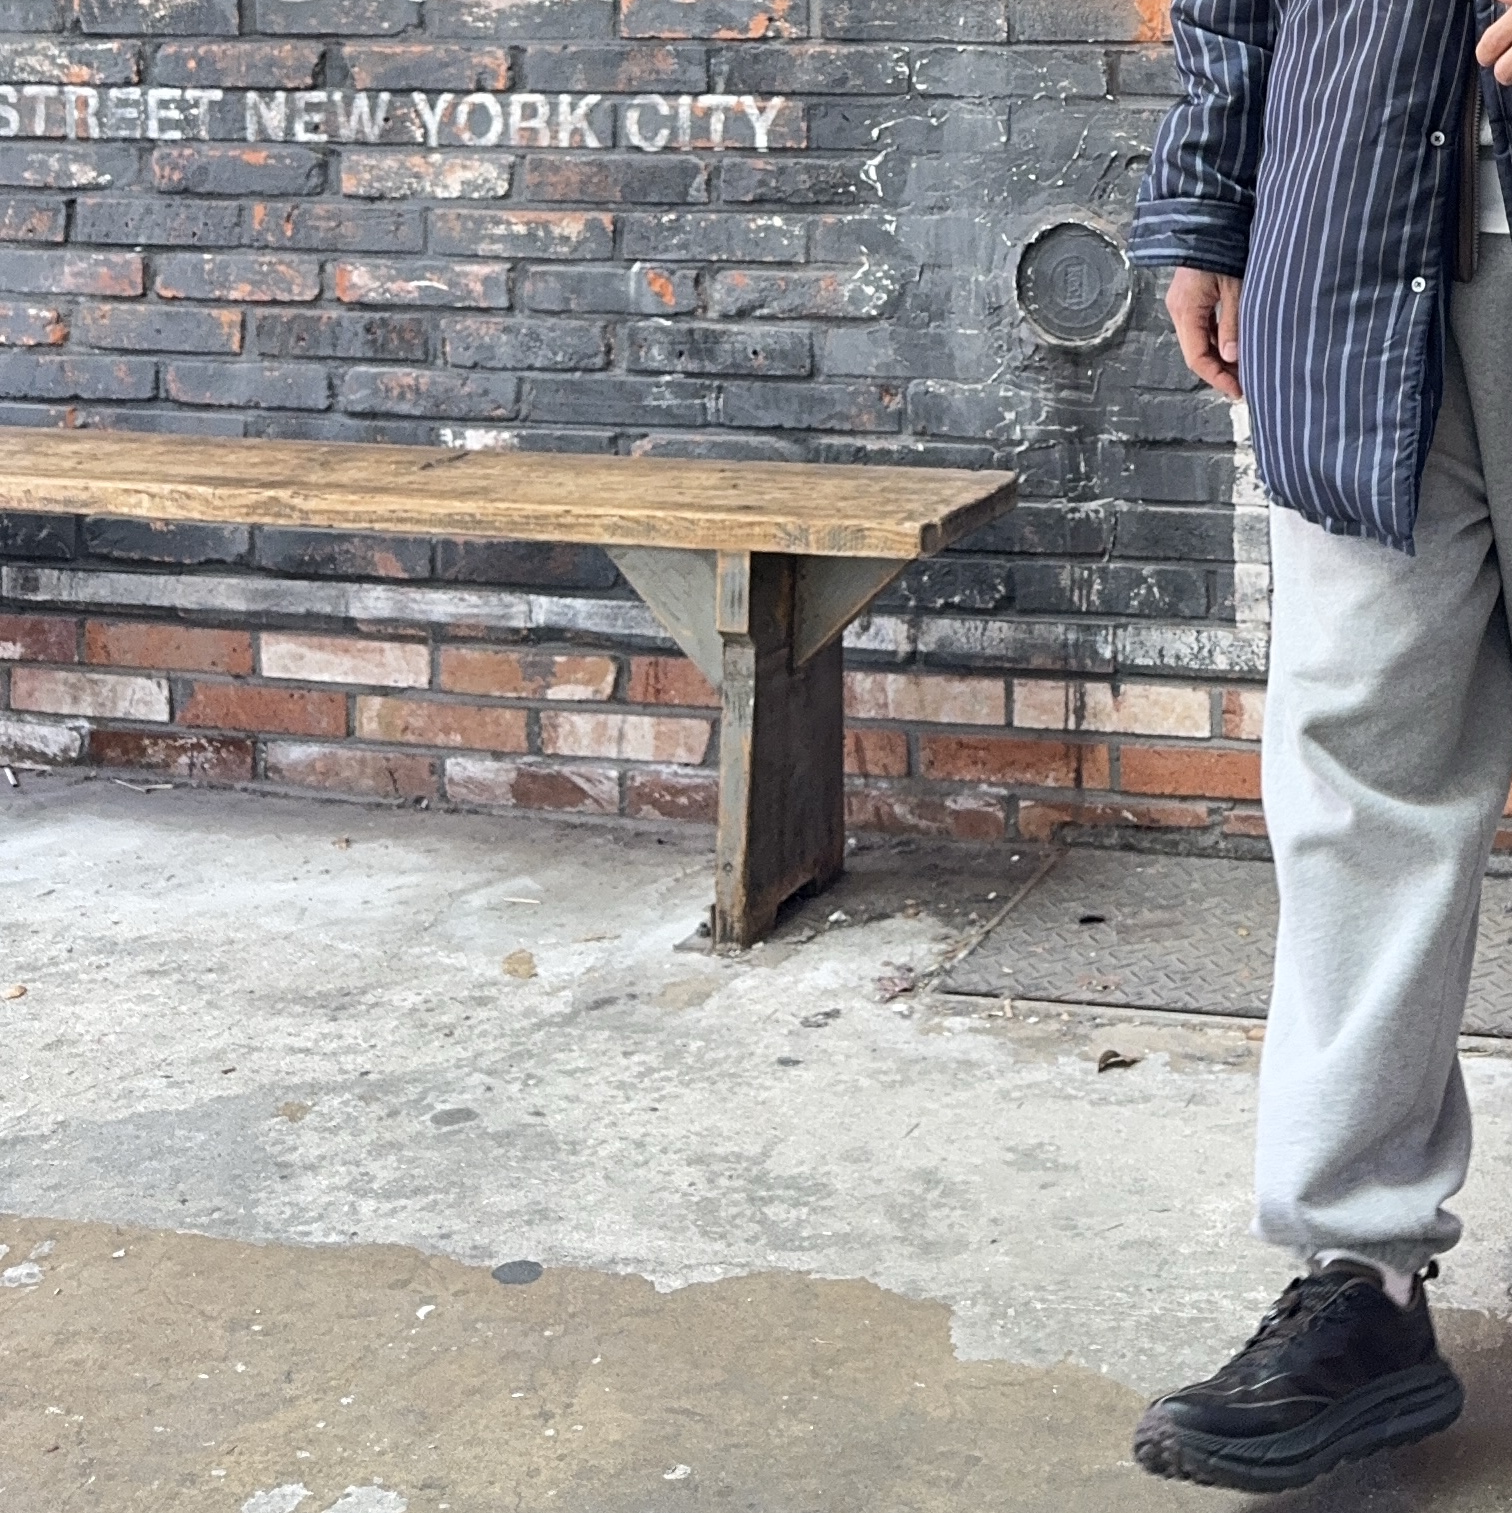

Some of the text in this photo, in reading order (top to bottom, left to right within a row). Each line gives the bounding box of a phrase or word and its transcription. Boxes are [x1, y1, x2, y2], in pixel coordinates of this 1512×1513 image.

[244, 89, 392, 144] NEW
[415, 91, 605, 150] YORK
[624, 94, 784, 152] CITY
